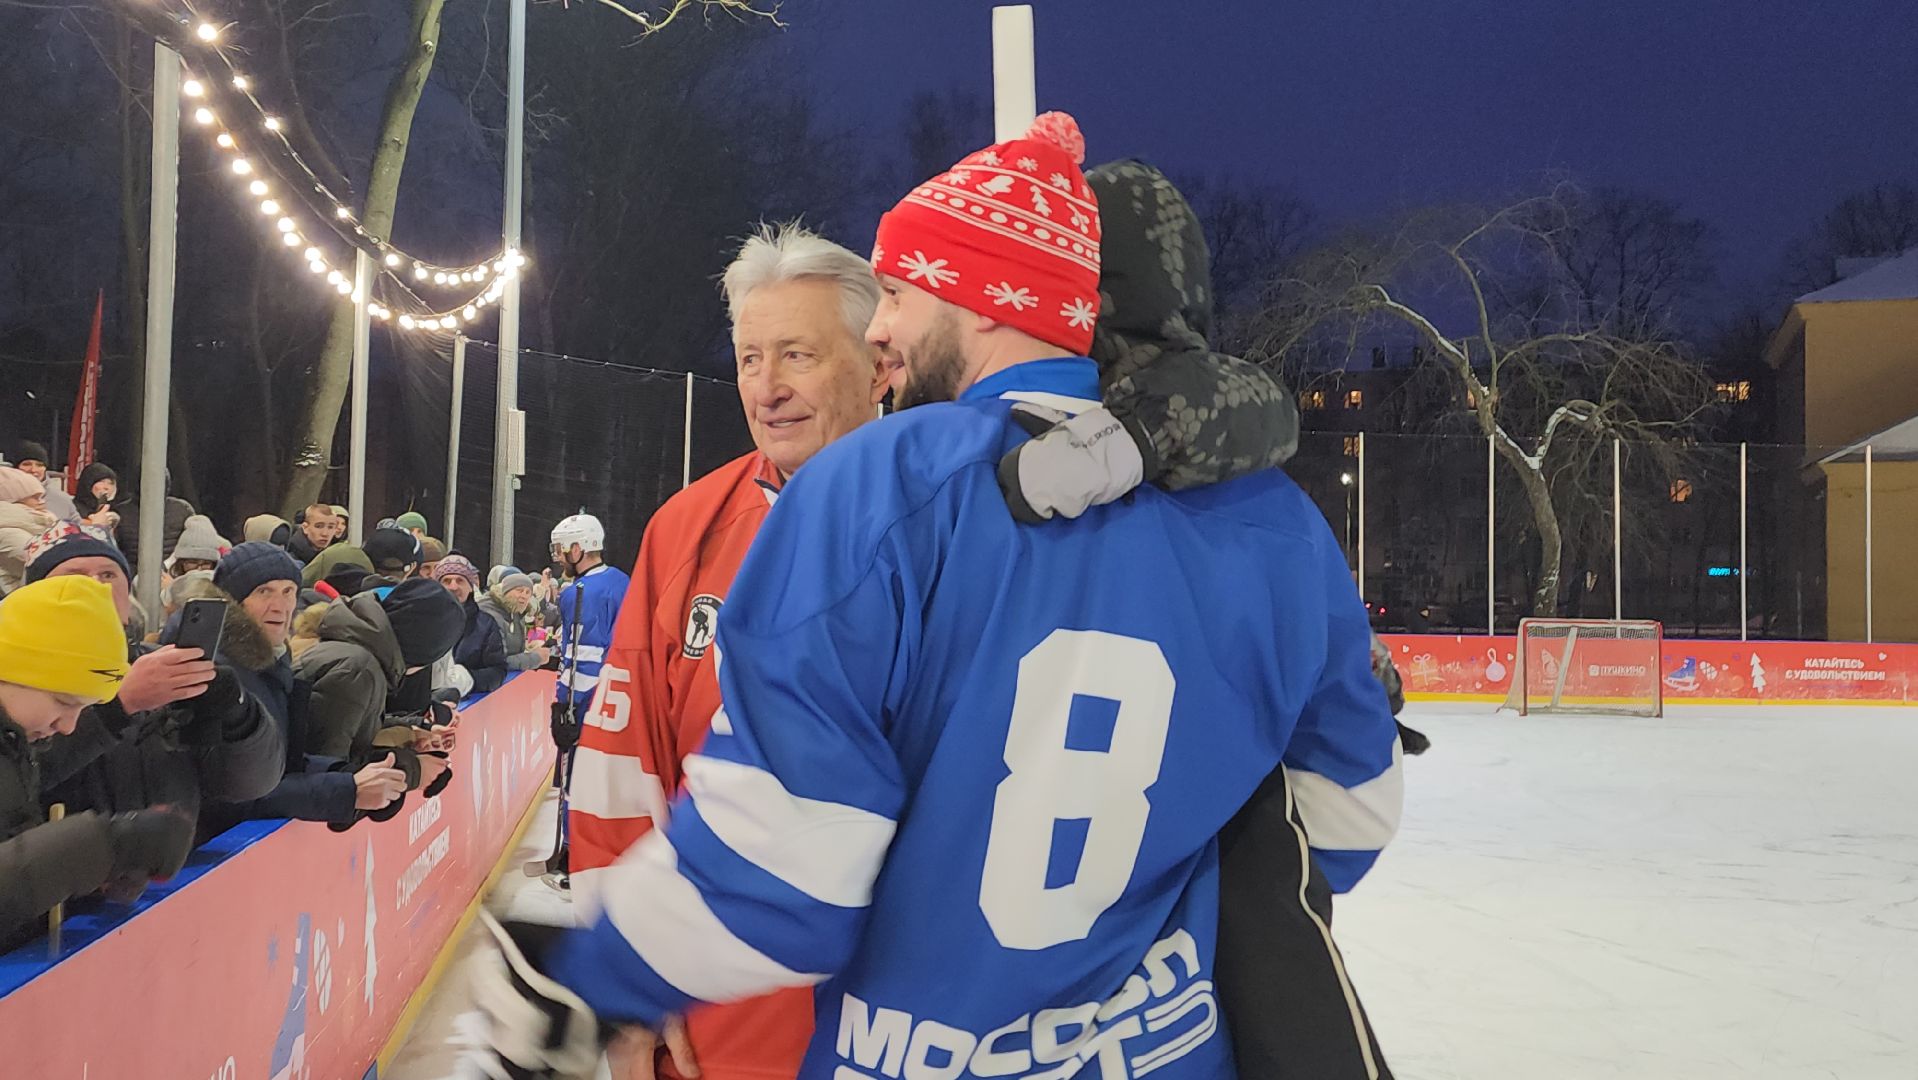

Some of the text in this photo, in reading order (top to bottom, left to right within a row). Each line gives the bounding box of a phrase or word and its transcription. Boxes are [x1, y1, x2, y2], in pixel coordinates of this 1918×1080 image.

[1600, 665, 1646, 677] ПУШКИНО
[1804, 657, 1865, 669] КАТАЙТЕСЬ
[583, 663, 632, 733] 15
[978, 628, 1177, 951] 8
